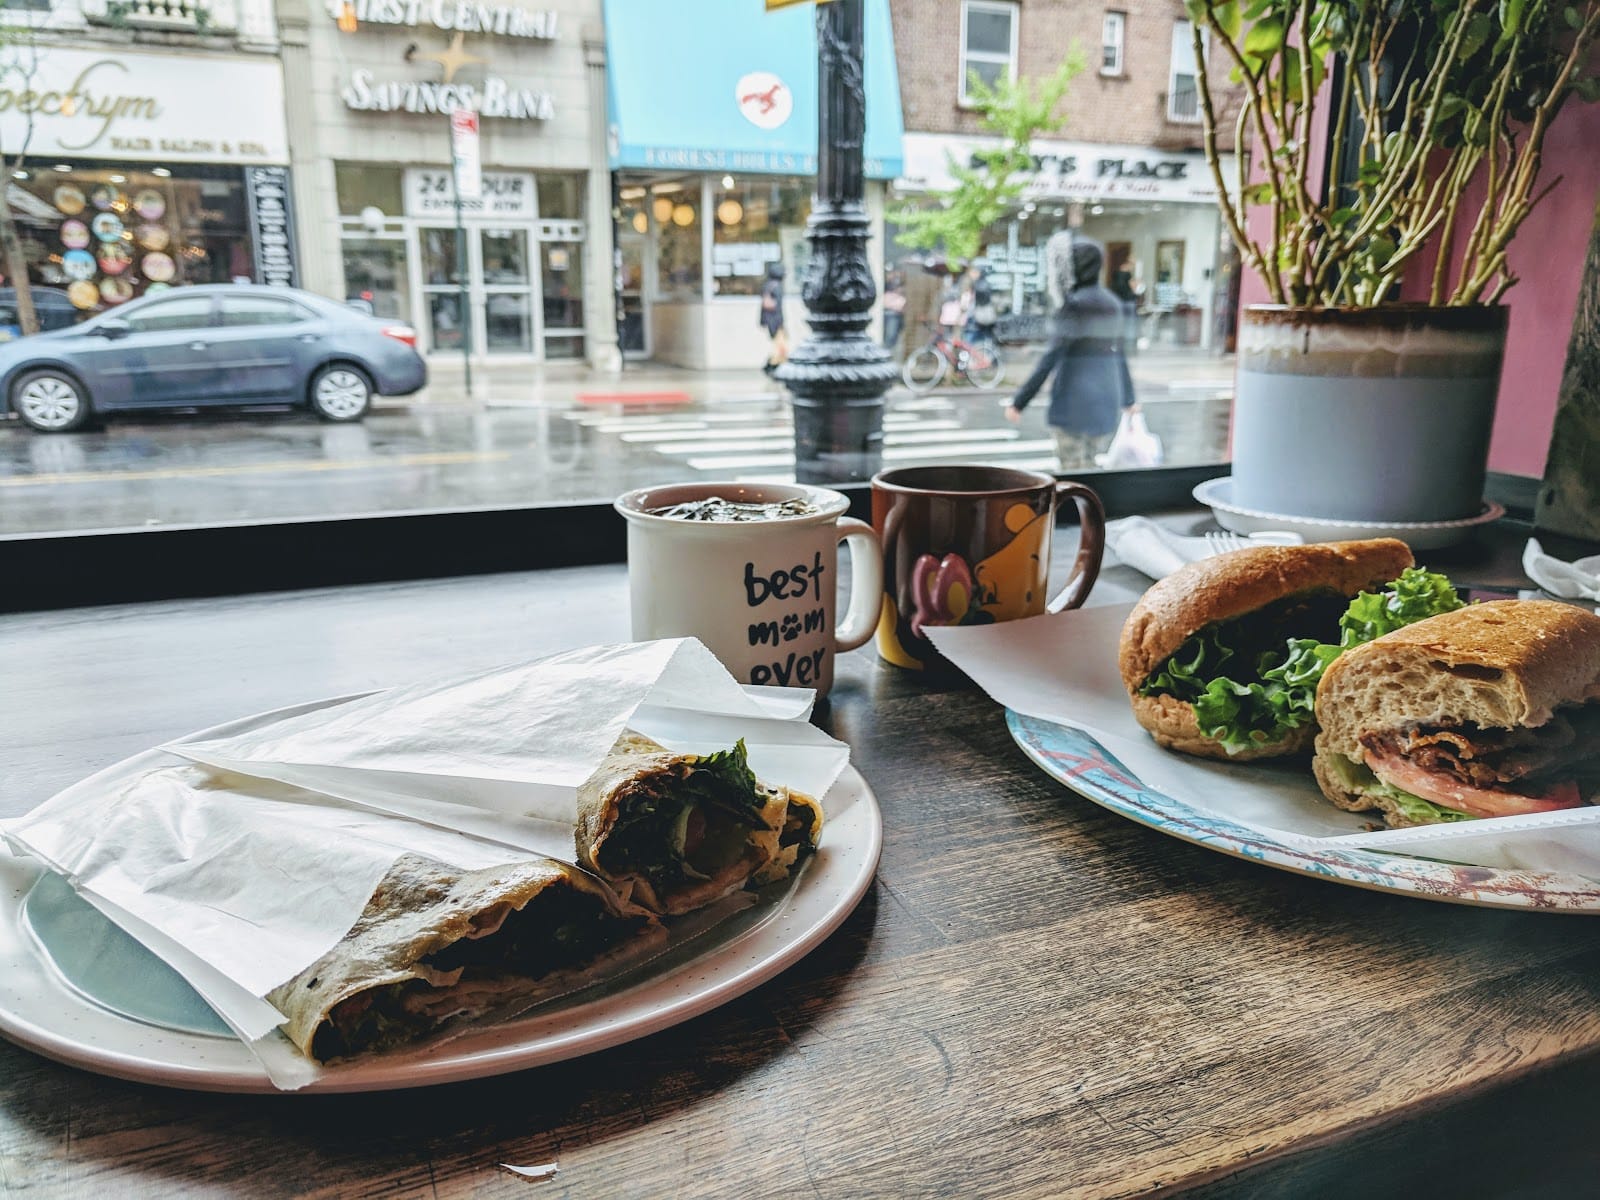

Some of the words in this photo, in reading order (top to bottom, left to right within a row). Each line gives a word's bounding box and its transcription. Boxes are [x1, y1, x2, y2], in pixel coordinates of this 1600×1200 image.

[431, 0, 559, 39] CENTRAL
[341, 68, 476, 115] SAVINGS
[481, 77, 556, 120] BANK
[419, 173, 447, 194] 24
[481, 176, 524, 196] OUR
[1096, 158, 1188, 179] PLACE
[744, 551, 825, 607] best
[750, 647, 826, 687] ever
